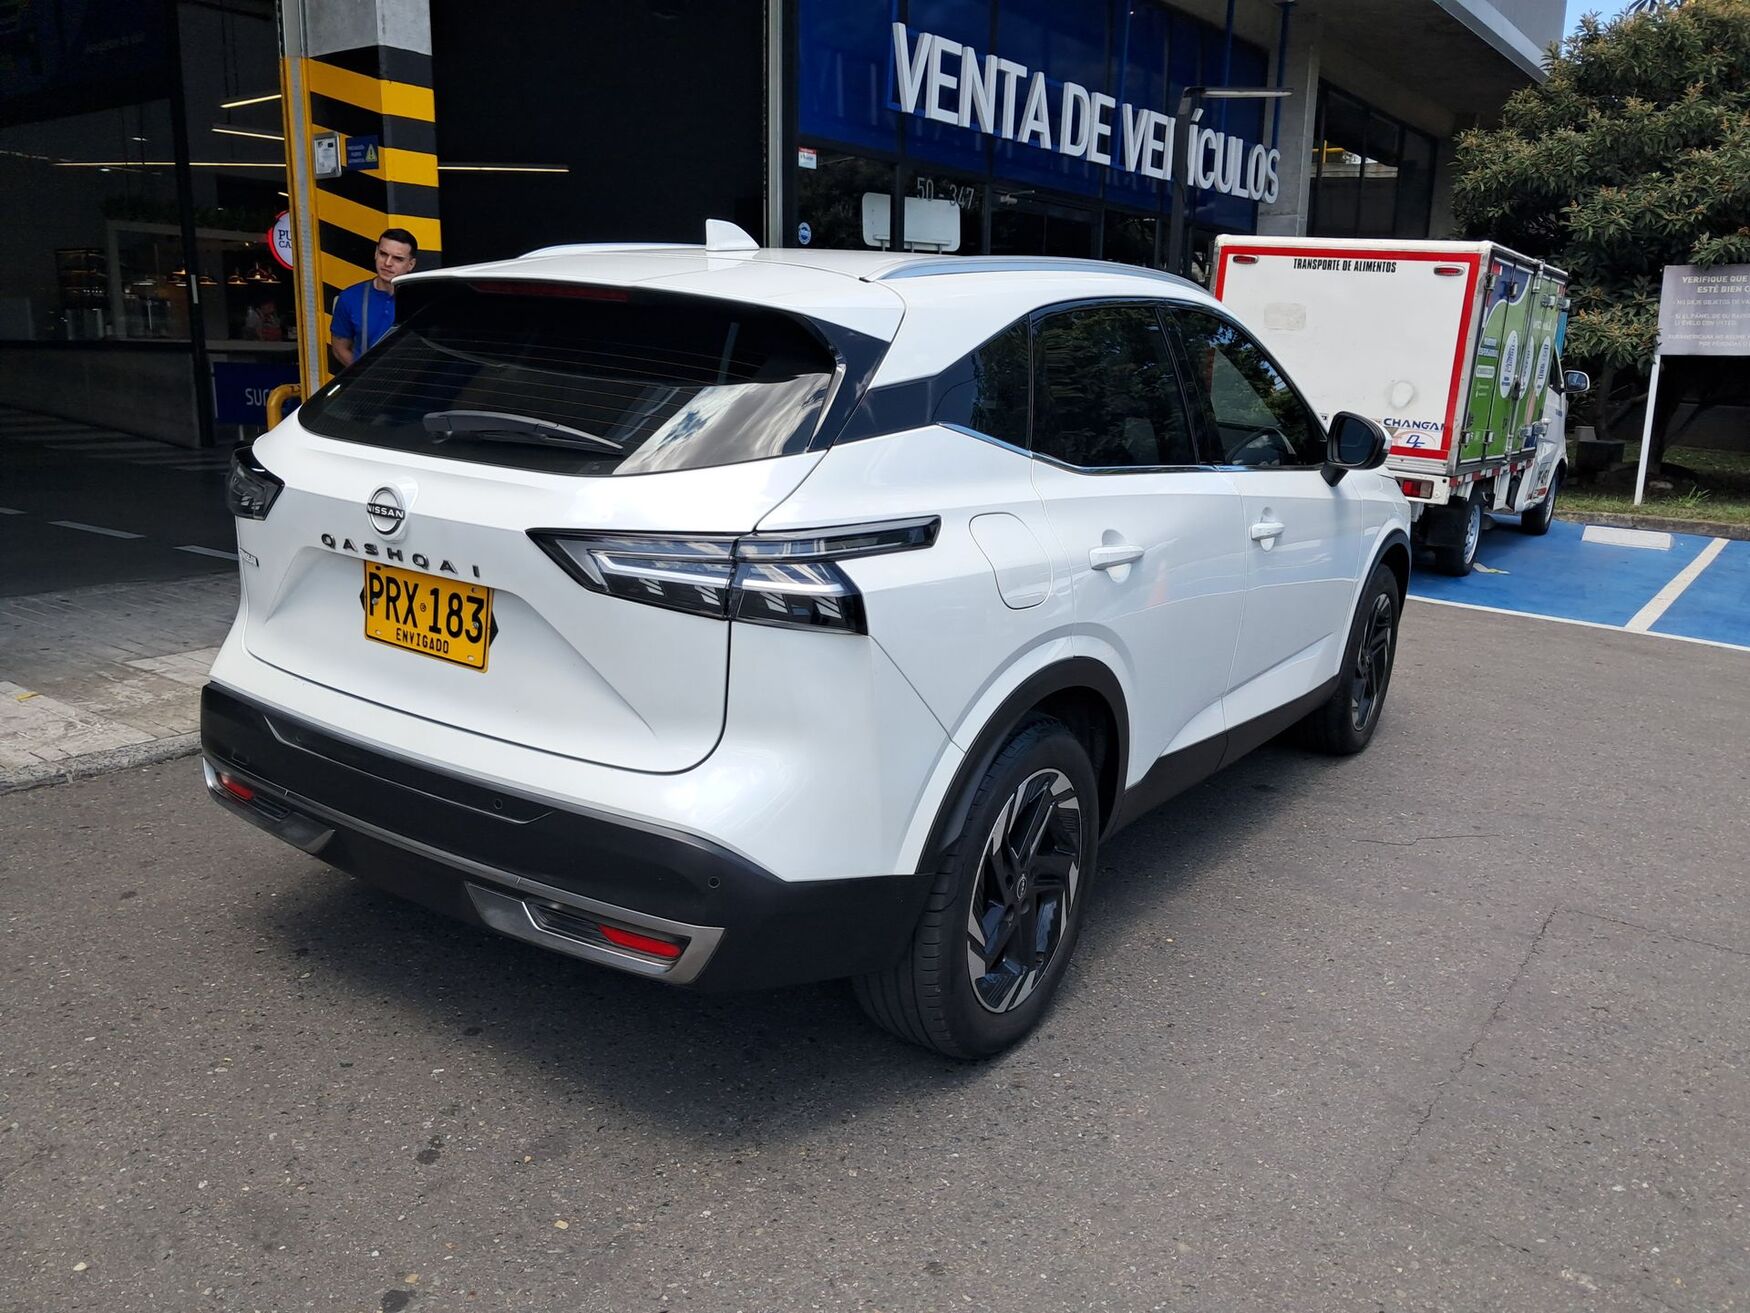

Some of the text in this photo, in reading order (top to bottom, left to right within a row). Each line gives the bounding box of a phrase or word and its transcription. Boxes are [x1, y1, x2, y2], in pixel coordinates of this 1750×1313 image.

[892, 22, 1052, 149] VENTA
[1060, 81, 1116, 165] DE
[917, 176, 934, 202] 50
[949, 184, 975, 210] 347
[1293, 258, 1397, 273] TRANSPORTE DE ALIMENTOS
[1682, 275, 1748, 284] VERIFIQUE QUE
[367, 504, 404, 518] NISSAN
[321, 533, 480, 578] QASHQAI
[396, 628, 449, 654] ENVIGADO
